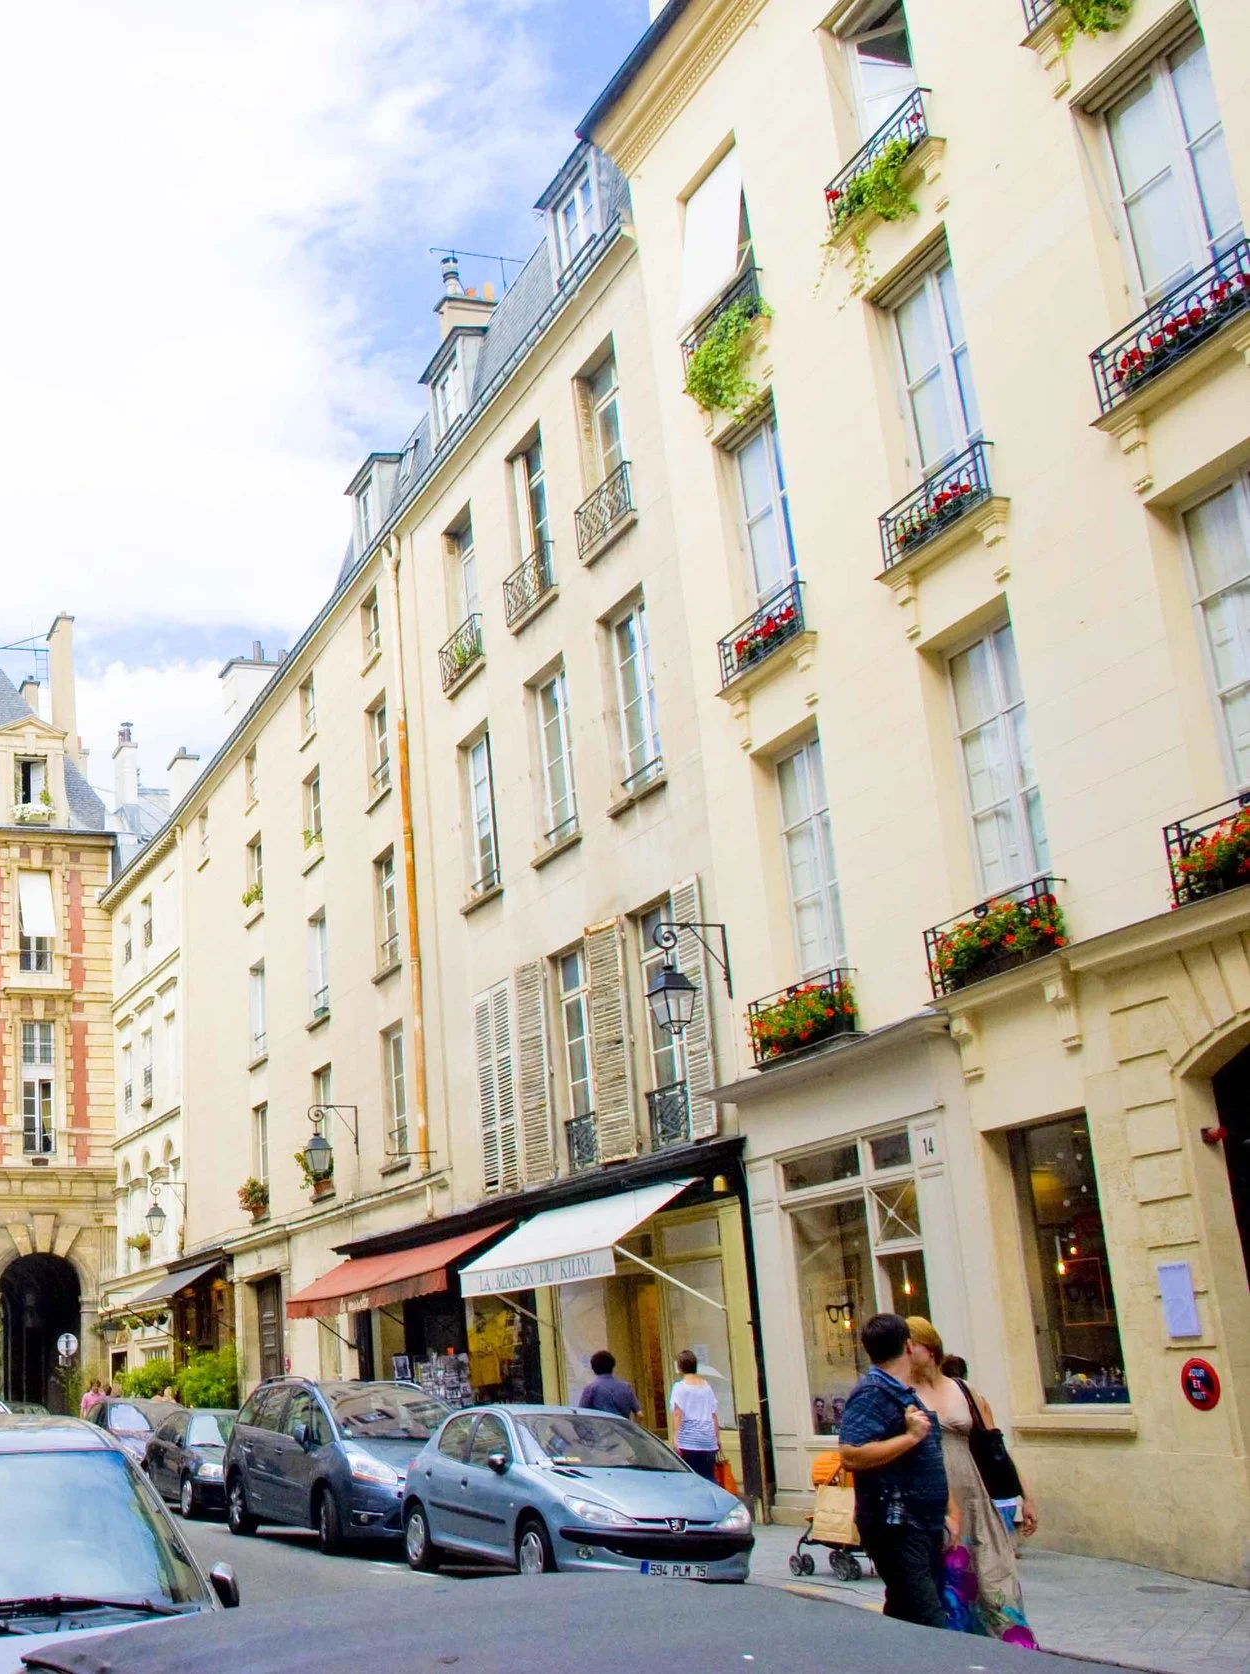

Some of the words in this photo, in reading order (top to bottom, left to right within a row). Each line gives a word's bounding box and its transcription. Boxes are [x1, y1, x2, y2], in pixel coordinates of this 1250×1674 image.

[922, 1136, 935, 1157] 14
[478, 1275, 492, 1292] LA
[495, 1265, 535, 1290] MAISON
[539, 1262, 555, 1283] DU
[559, 1256, 592, 1280] KILIM
[1187, 1367, 1206, 1378] JOUR
[1192, 1379, 1202, 1389] ET
[650, 1564, 668, 1576] 594
[694, 1565, 707, 1577] 75
